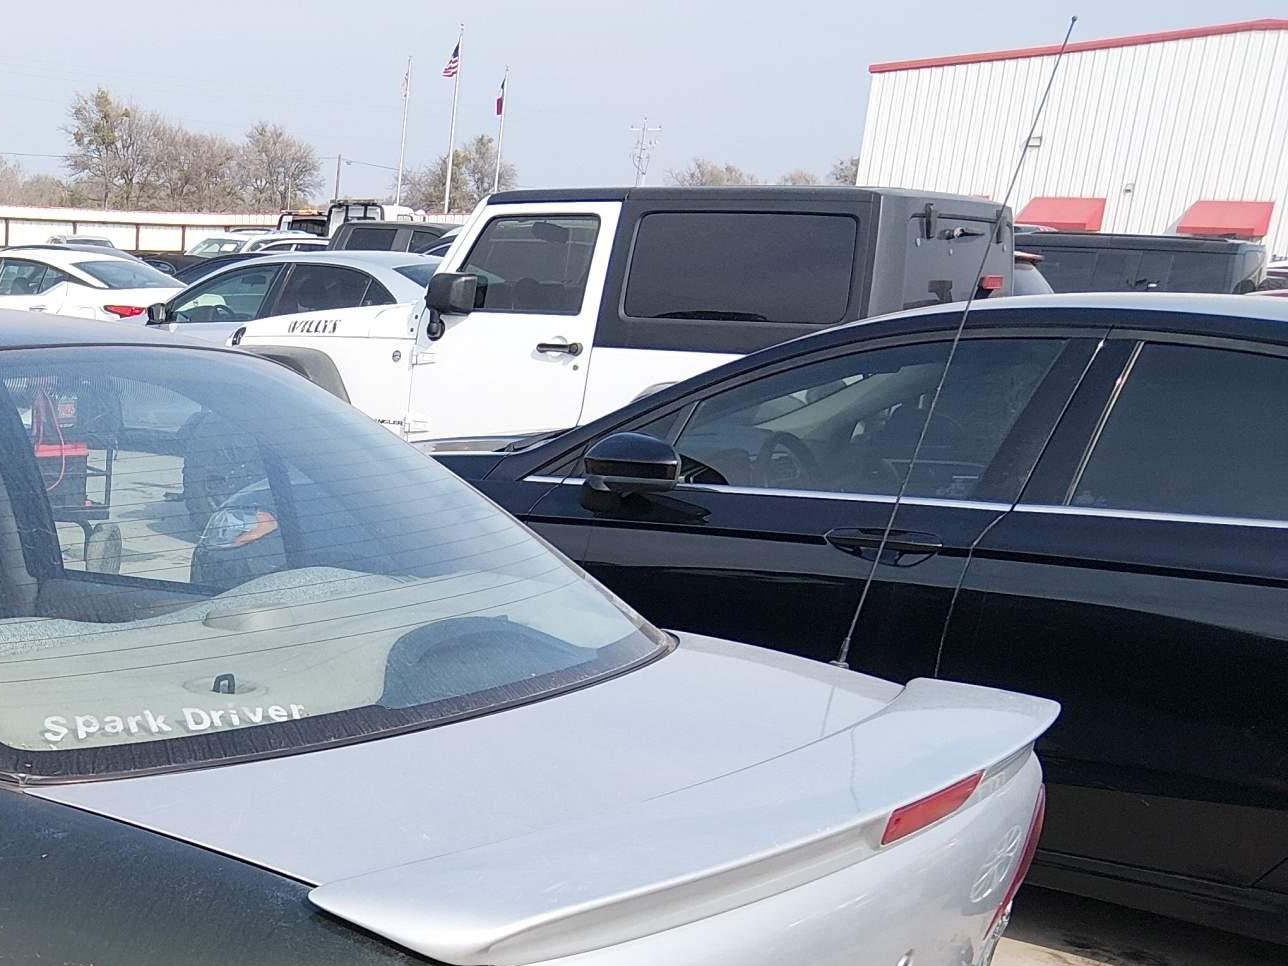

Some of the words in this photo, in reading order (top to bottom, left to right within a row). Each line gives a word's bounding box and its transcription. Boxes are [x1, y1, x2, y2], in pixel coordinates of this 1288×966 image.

[287, 319, 342, 334] WILLYS
[43, 710, 173, 742] Spark
[182, 702, 307, 731] Driver
